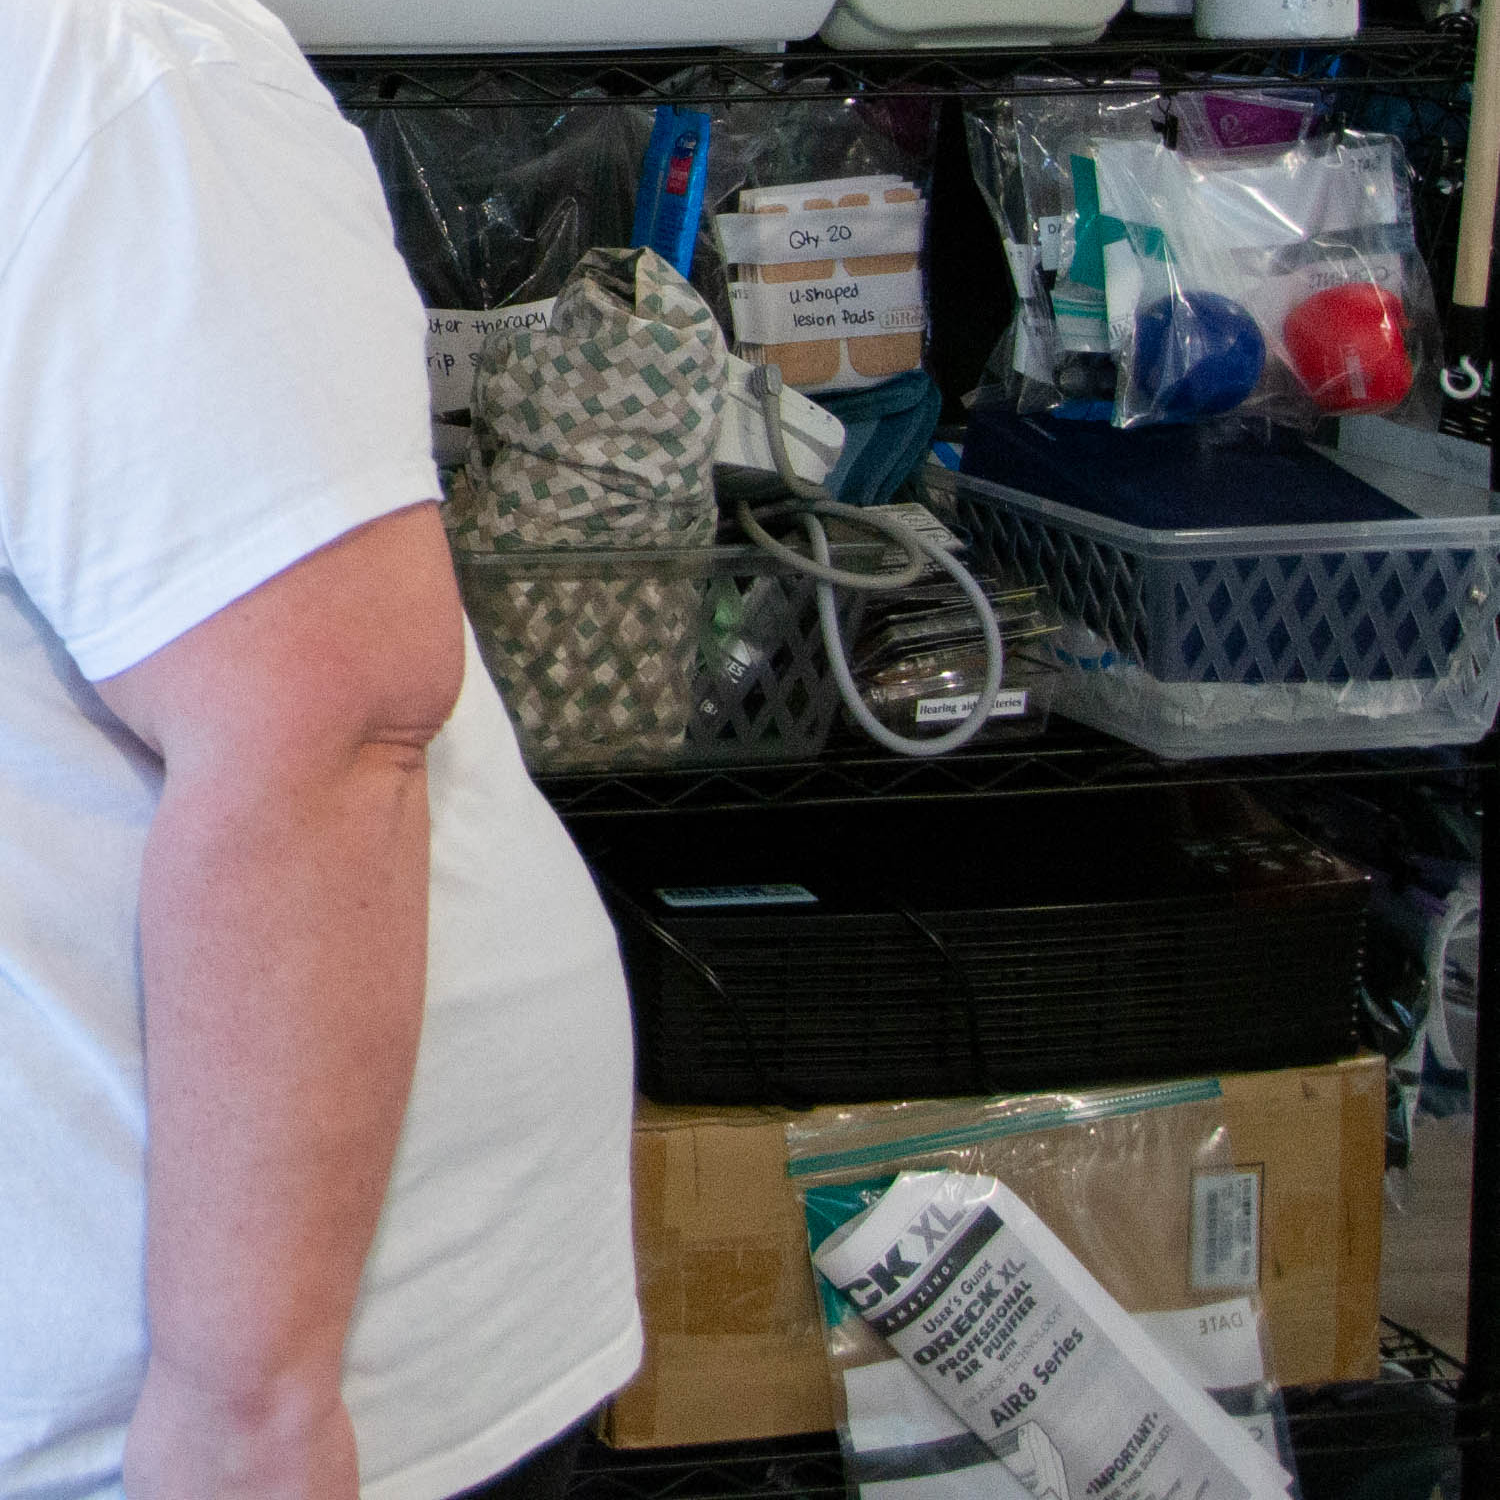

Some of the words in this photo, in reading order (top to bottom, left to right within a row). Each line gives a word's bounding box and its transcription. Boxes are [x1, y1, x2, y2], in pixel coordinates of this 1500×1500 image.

[827, 226, 852, 242] 20
[472, 310, 547, 334] therapy
[793, 312, 836, 327] lesion
[920, 702, 957, 716] Hearing
[908, 1202, 964, 1256] XL
[914, 1280, 1003, 1366] ORECK
[997, 1257, 1027, 1286] XL
[936, 1280, 1033, 1377] PROFESSIONAL
[955, 1359, 984, 1385] AIR
[982, 1296, 1038, 1360] PURIFIER
[990, 1383, 1038, 1429] AIR8
[1033, 1327, 1085, 1386] Series
